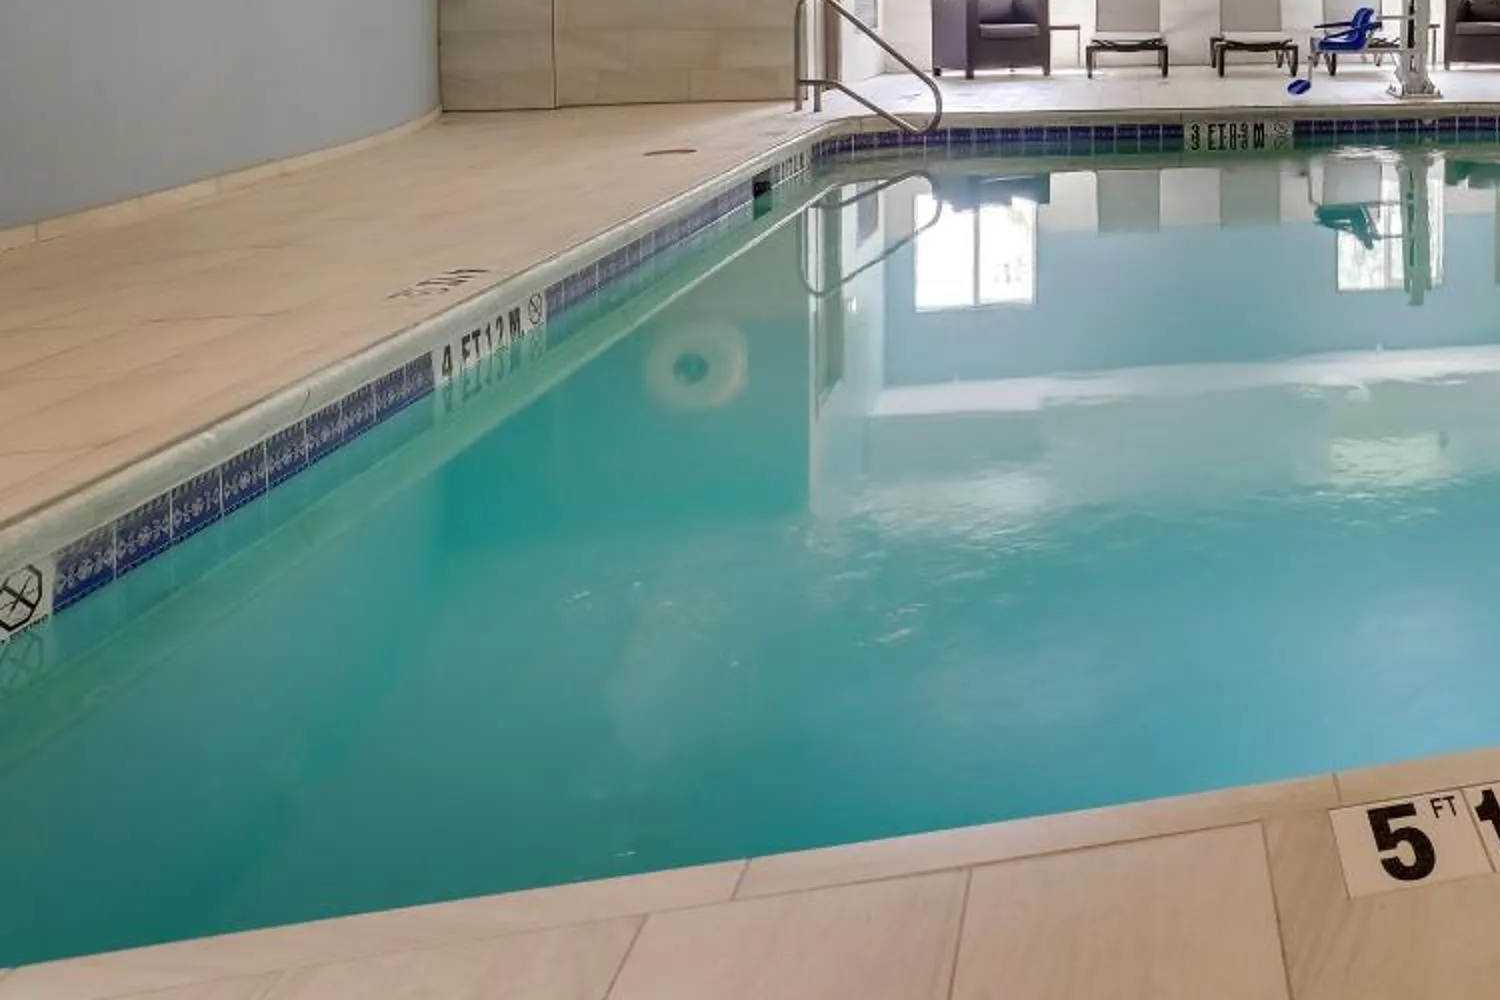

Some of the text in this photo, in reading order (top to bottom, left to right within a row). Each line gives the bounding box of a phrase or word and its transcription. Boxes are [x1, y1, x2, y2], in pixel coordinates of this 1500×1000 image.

[441, 344, 453, 377] 4
[1367, 795, 1458, 881] 5 FT
